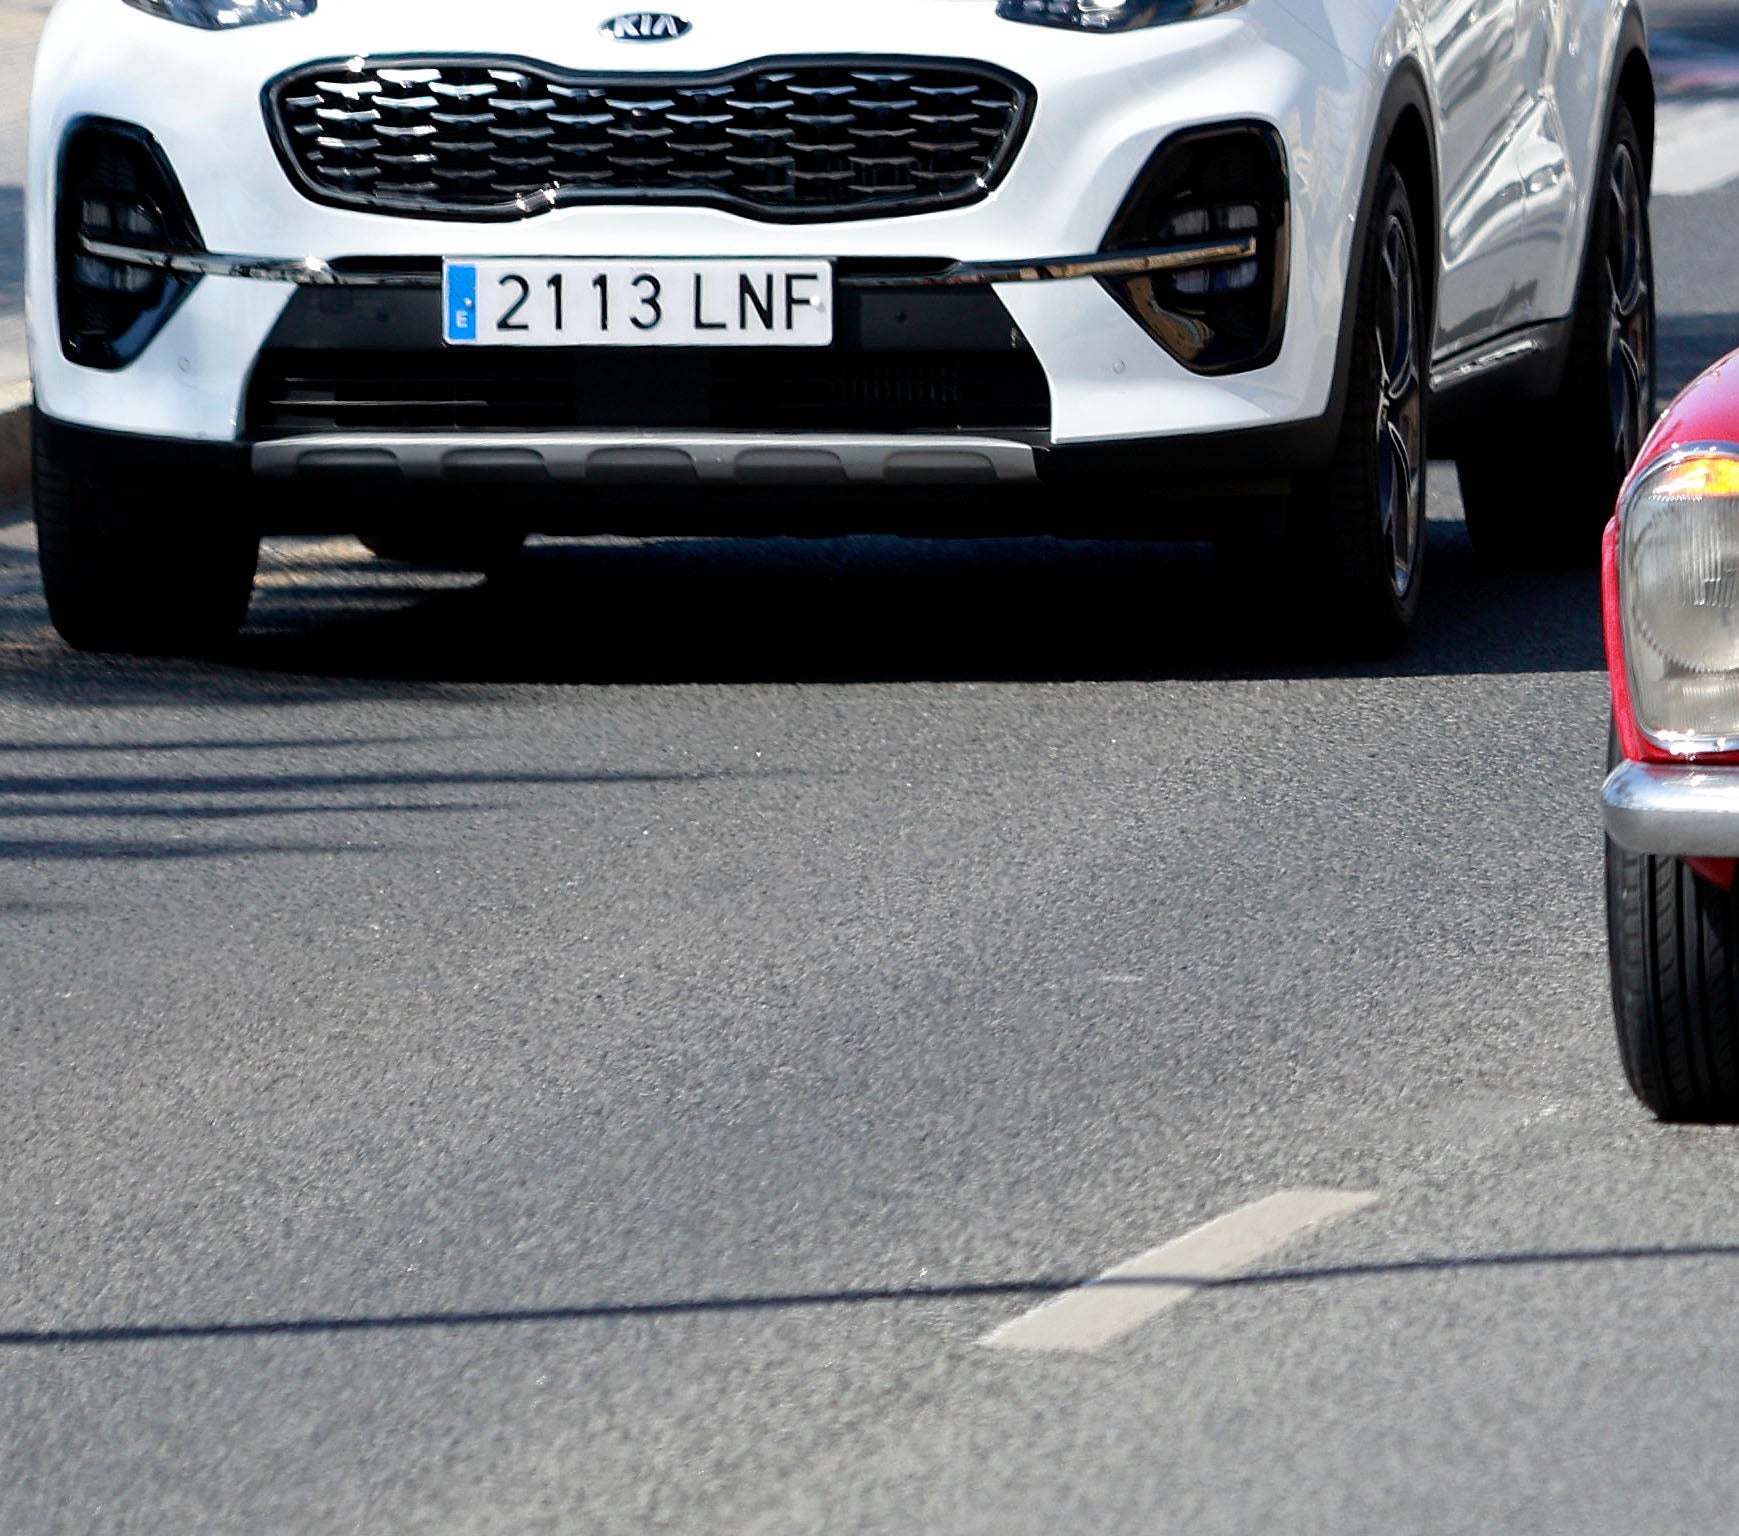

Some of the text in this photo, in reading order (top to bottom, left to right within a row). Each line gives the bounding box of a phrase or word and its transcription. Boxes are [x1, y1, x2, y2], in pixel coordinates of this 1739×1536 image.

[613, 13, 678, 38] KIA
[496, 272, 820, 332] 2113 LNF
[455, 309, 469, 329] E
